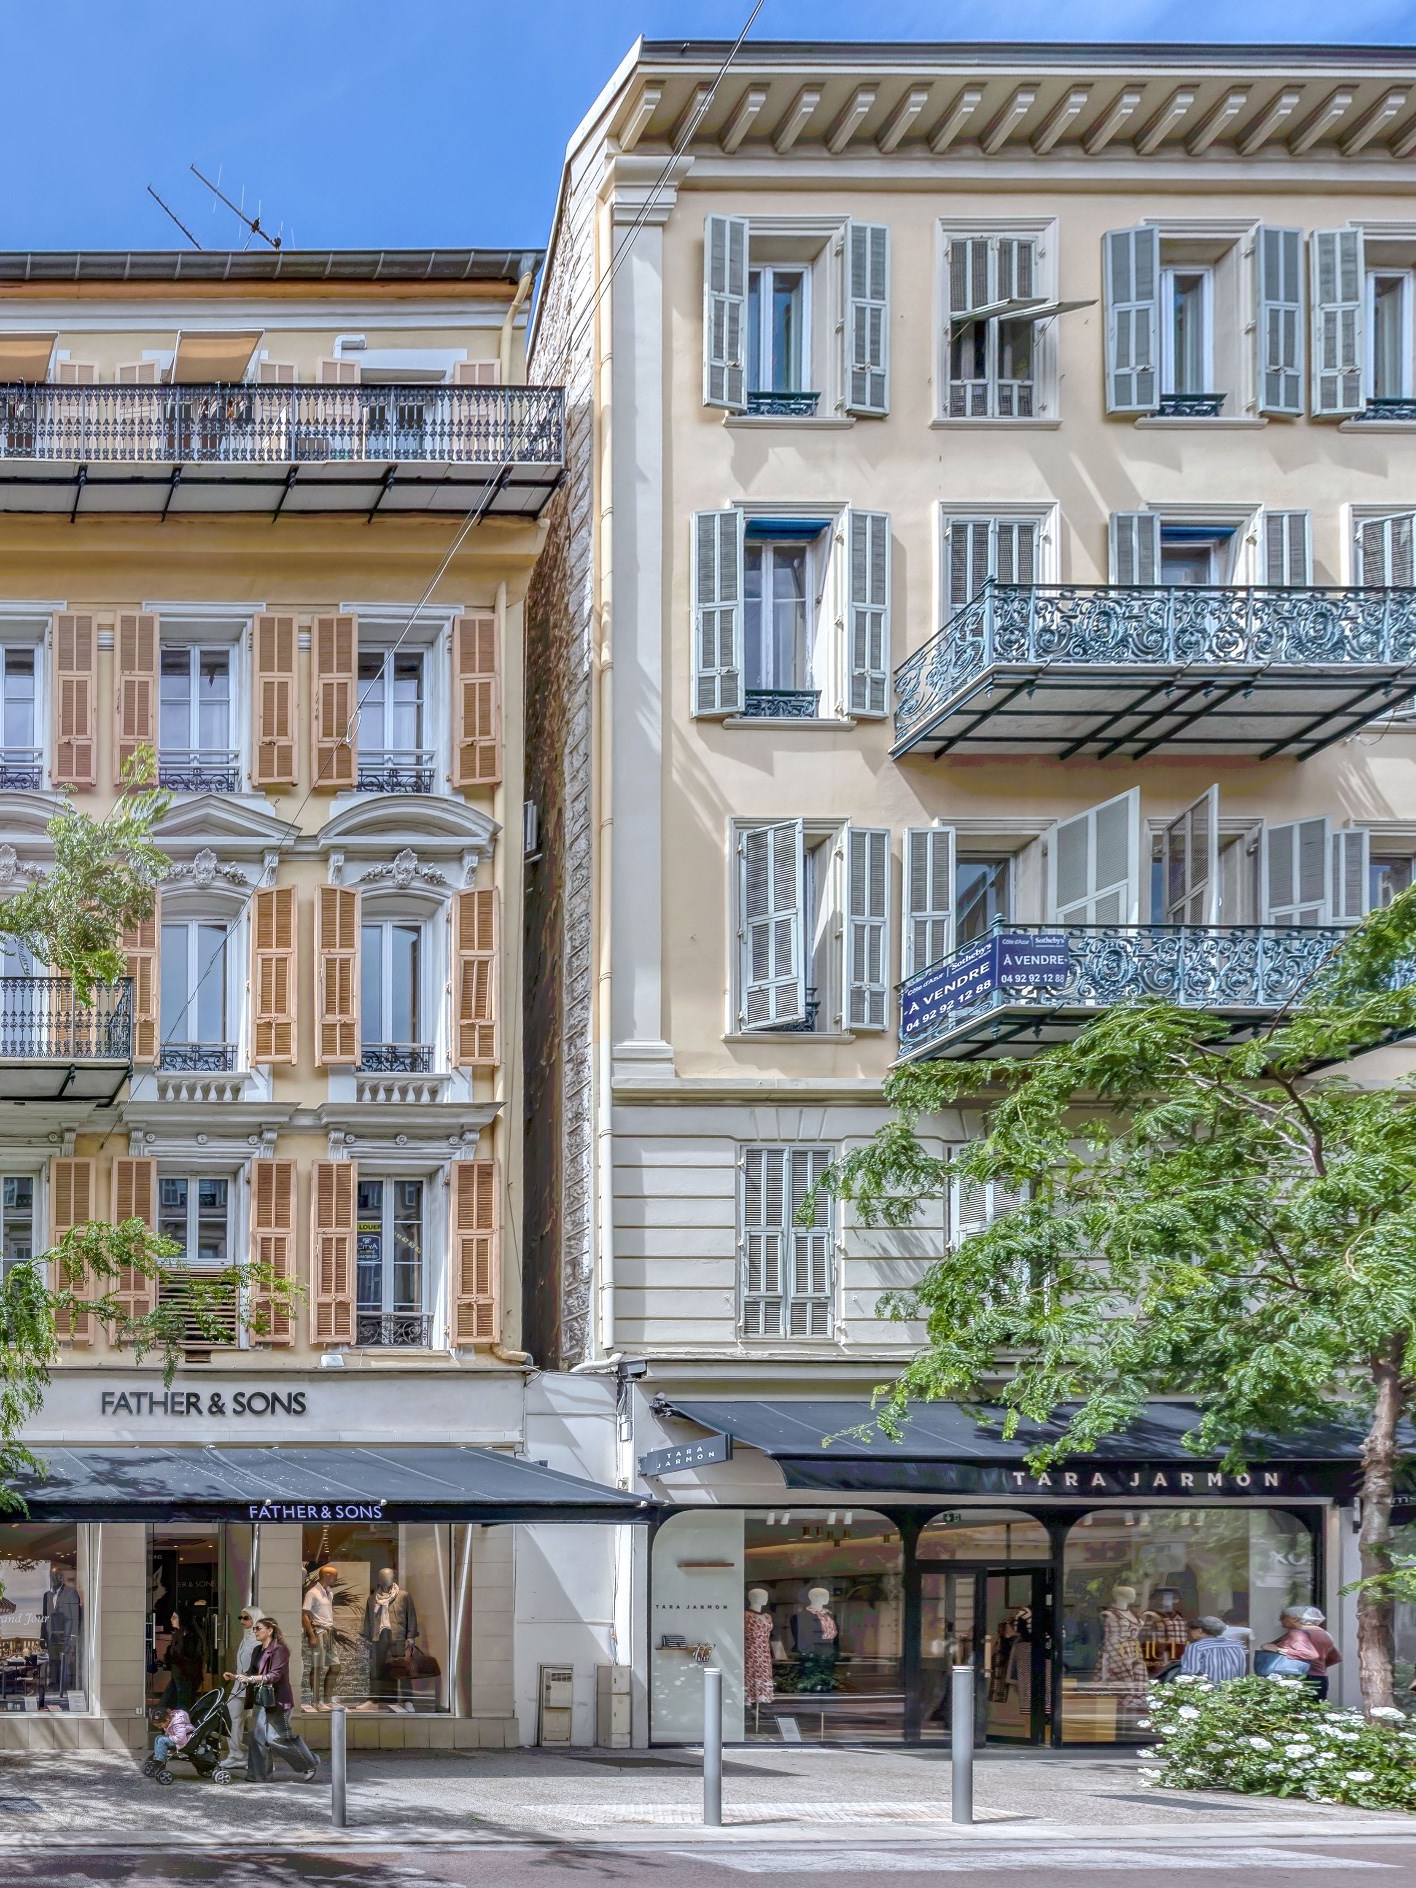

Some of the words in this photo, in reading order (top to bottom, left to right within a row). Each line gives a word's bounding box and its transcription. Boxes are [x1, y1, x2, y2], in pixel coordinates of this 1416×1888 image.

[1035, 936, 1065, 945] Sotheby's
[949, 943, 992, 971] Sotheby's
[1014, 955, 1064, 965] VENDRE
[1001, 974, 1013, 983] 04
[1014, 974, 1027, 983] 92
[1028, 974, 1041, 983] 92
[1042, 974, 1054, 983] 12
[908, 1001, 920, 1015] À
[923, 961, 990, 1005] VENDRE
[906, 1018, 920, 1032] 04
[922, 1010, 937, 1023] 92
[939, 1000, 955, 1013] 92
[957, 989, 973, 1003] 12
[975, 980, 991, 994] 88
[101, 1391, 203, 1416] FATHER
[207, 1391, 226, 1416] &
[232, 1391, 307, 1416] SONS
[667, 1446, 703, 1459] TARA
[656, 1451, 715, 1469] JARMON
[1012, 1472, 1106, 1487] TARA
[1129, 1472, 1279, 1487] JARMON
[249, 1505, 320, 1519] FATHER
[320, 1505, 332, 1519] &
[335, 1505, 383, 1519] SONS
[23, 1612, 50, 1626] Jour
